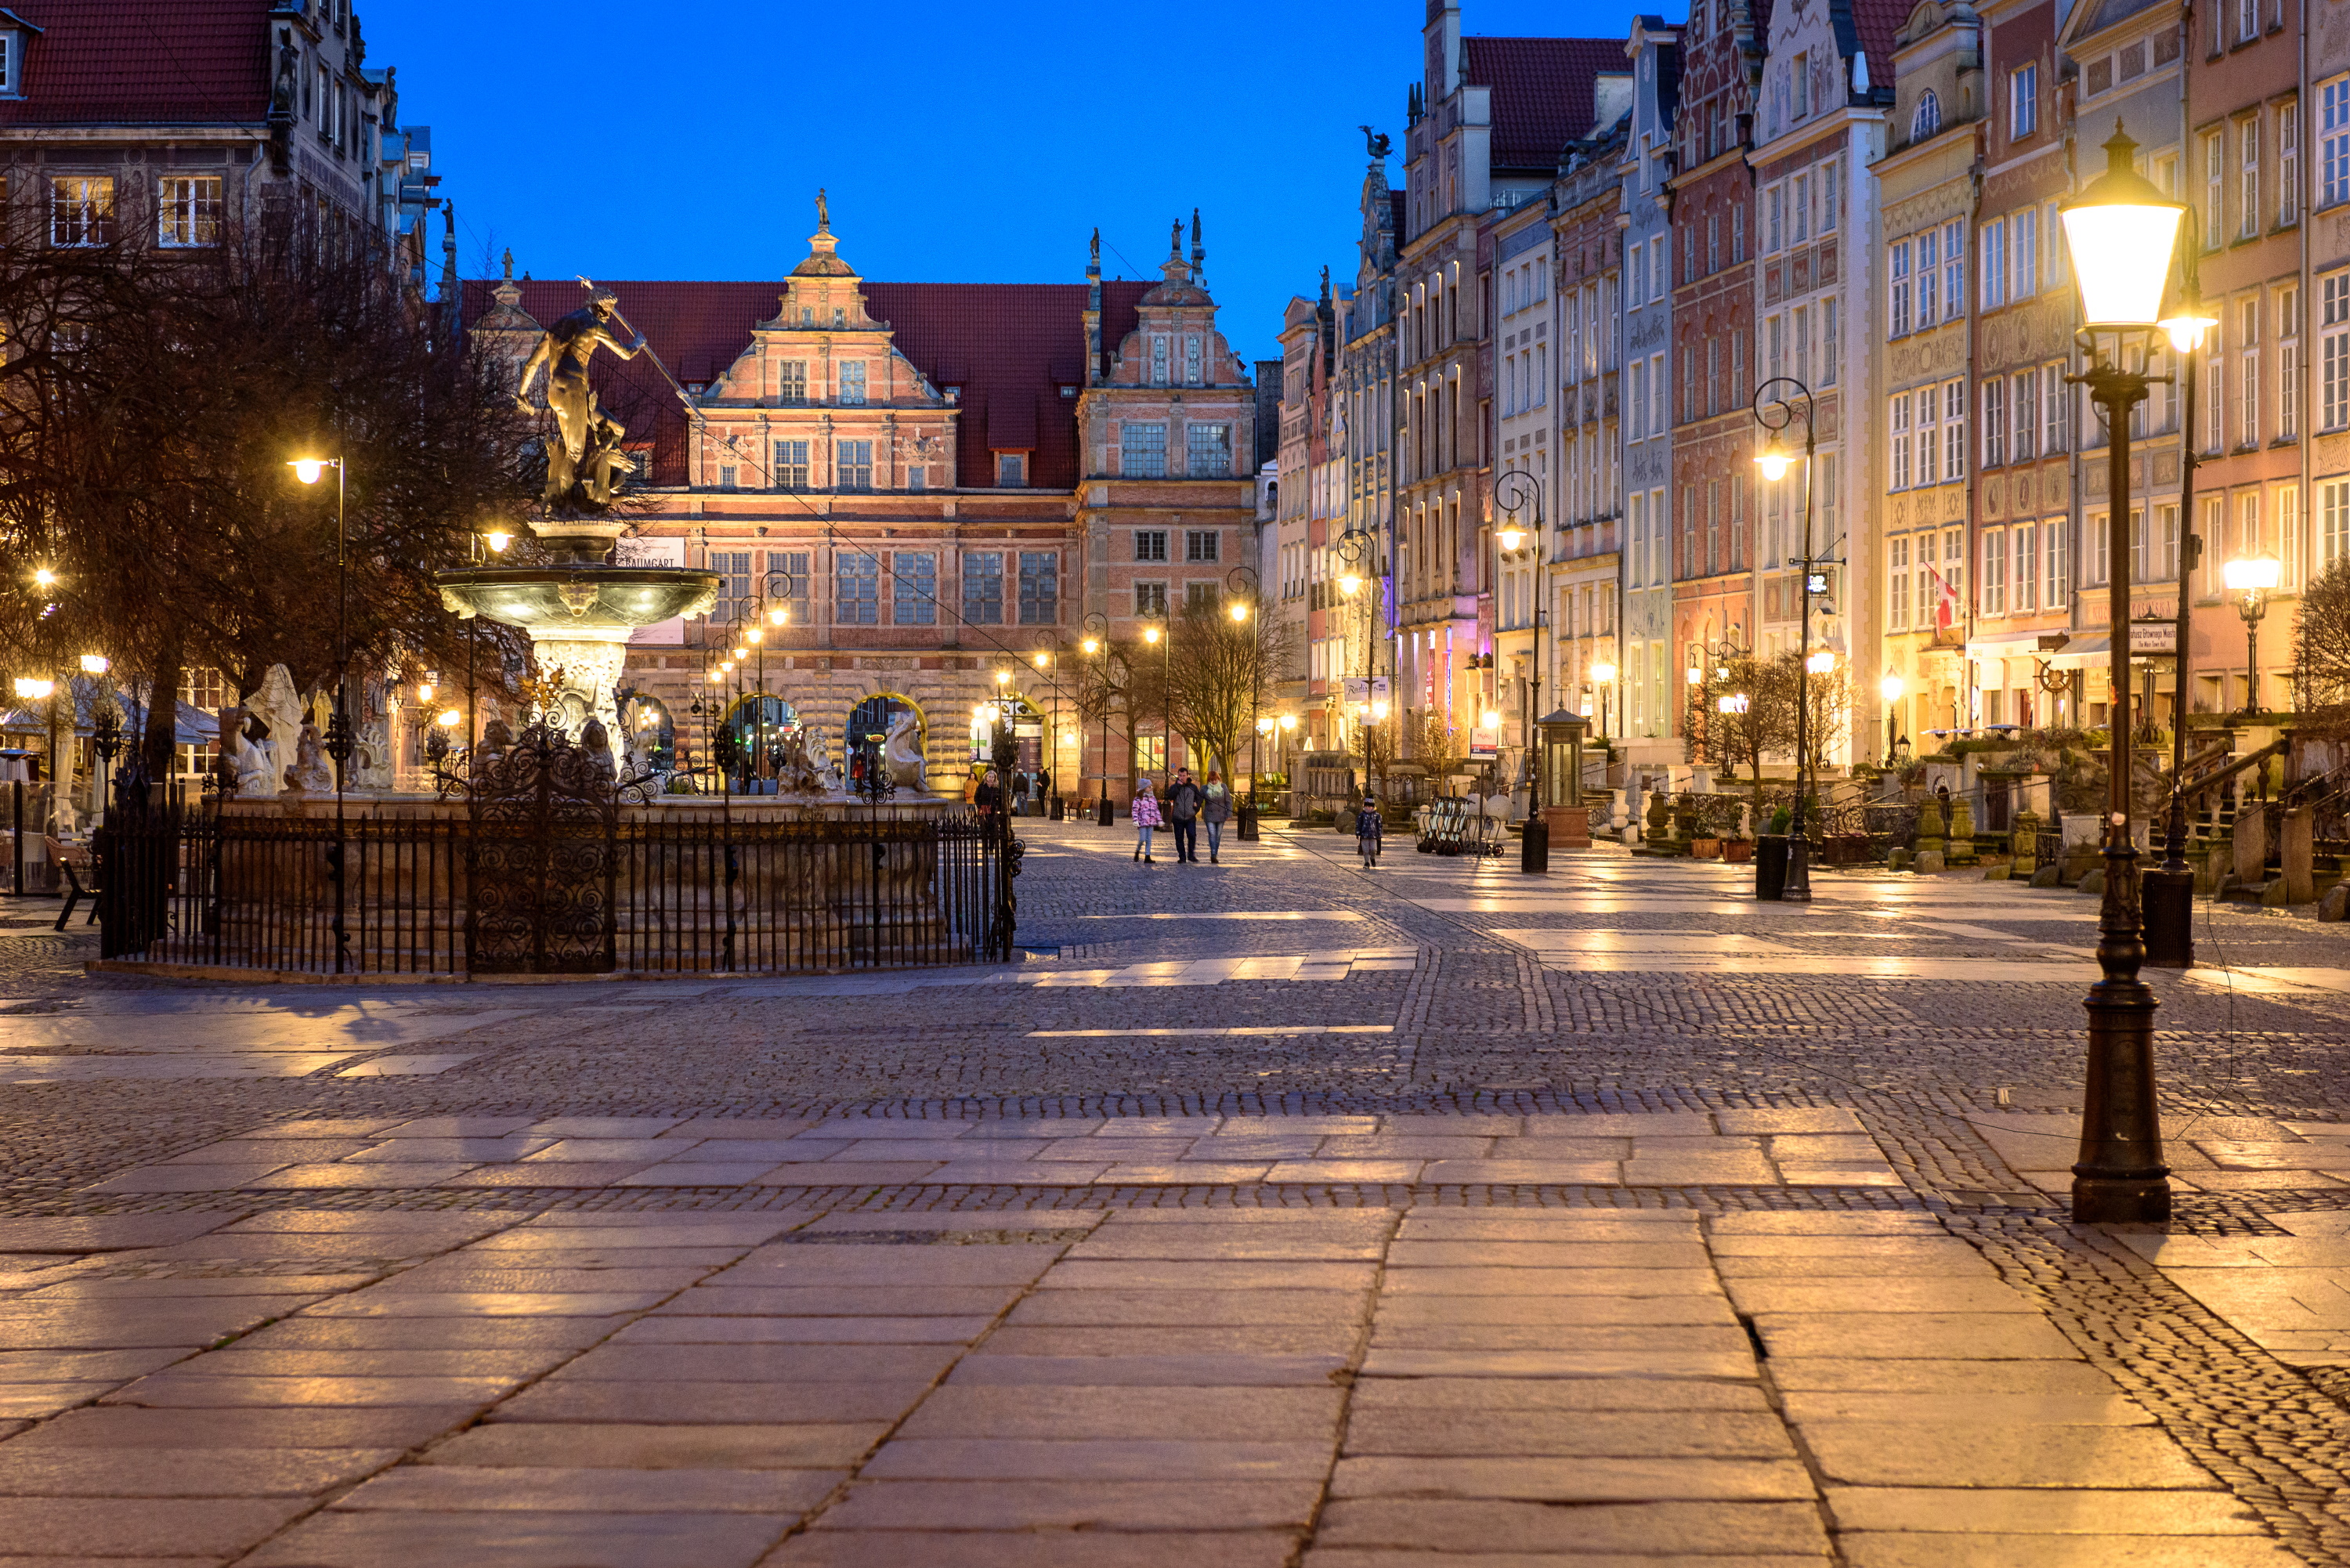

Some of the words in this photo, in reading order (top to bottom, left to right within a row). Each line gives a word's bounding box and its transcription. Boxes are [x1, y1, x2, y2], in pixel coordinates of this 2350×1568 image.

[625, 558, 674, 568] BAUMGART
[2130, 629, 2142, 638] atusz
[2163, 628, 2176, 638] Miasta
